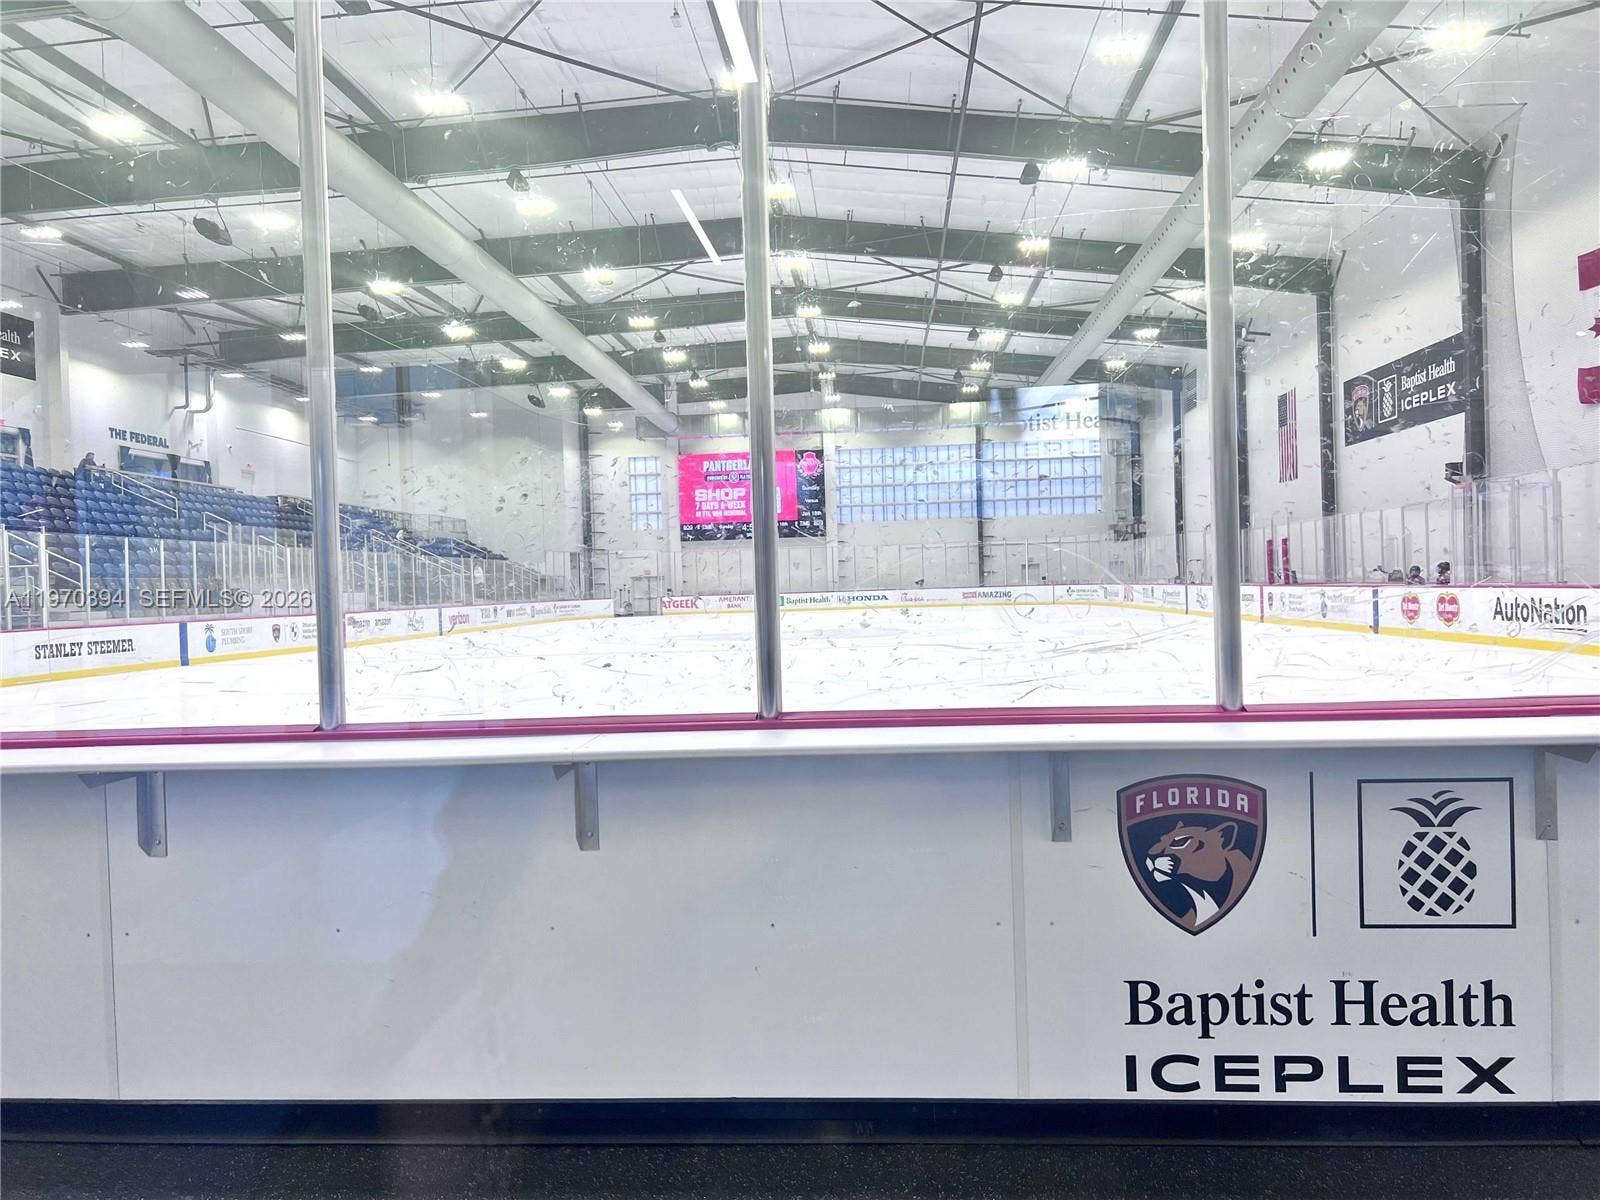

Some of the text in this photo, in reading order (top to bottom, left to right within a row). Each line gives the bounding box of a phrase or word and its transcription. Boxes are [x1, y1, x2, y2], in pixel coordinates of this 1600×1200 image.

[0, 329, 20, 345] alth
[1401, 356, 1456, 394] Baptist Health
[1401, 381, 1456, 411] ICEPLEX
[108, 427, 170, 449] THE FEDERAL
[694, 487, 746, 501] SHOP
[695, 502, 700, 511] 7
[701, 501, 719, 510] DAYS
[727, 500, 746, 509] WEEK
[786, 597, 808, 605] Baptist
[810, 596, 831, 604] Health
[847, 594, 889, 602] HONDA
[977, 591, 1012, 599] AMAZING
[448, 612, 470, 626] verizon
[1493, 596, 1588, 625] AutoNation
[34, 638, 134, 660] STANLEY STEEMER
[1135, 785, 1249, 814] FLORIDA
[1124, 978, 1516, 1039] Baptist Health
[1125, 1054, 1516, 1094] ICEPLEX
